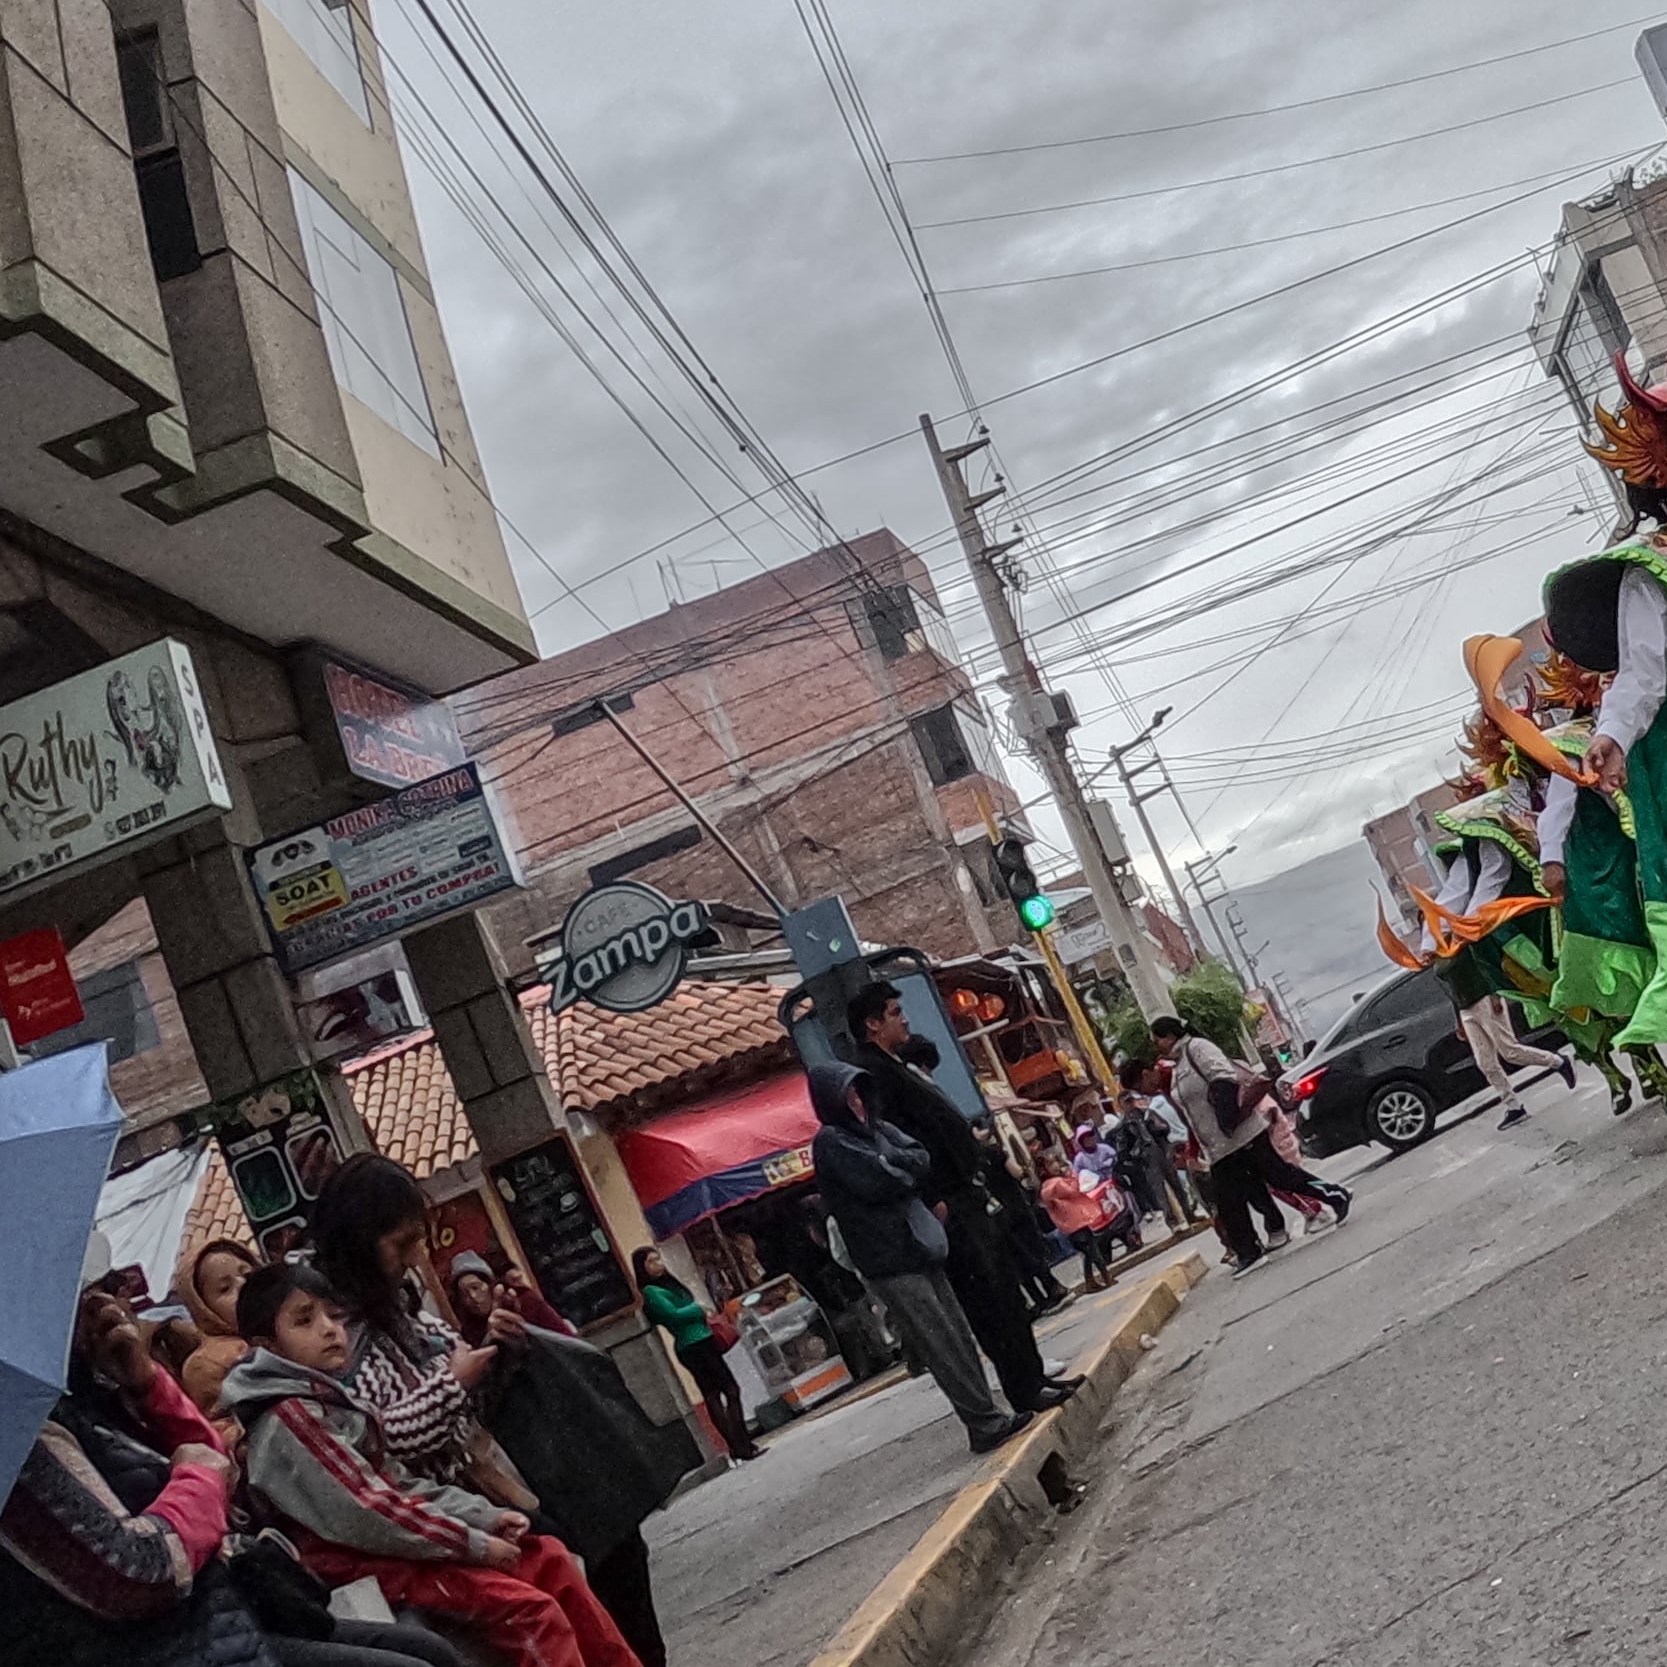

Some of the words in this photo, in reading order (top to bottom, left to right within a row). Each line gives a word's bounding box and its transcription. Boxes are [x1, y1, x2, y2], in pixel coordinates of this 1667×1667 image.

[181, 664, 222, 787] SPA
[275, 874, 332, 907] SOAT
[543, 903, 700, 1013] Zampa
